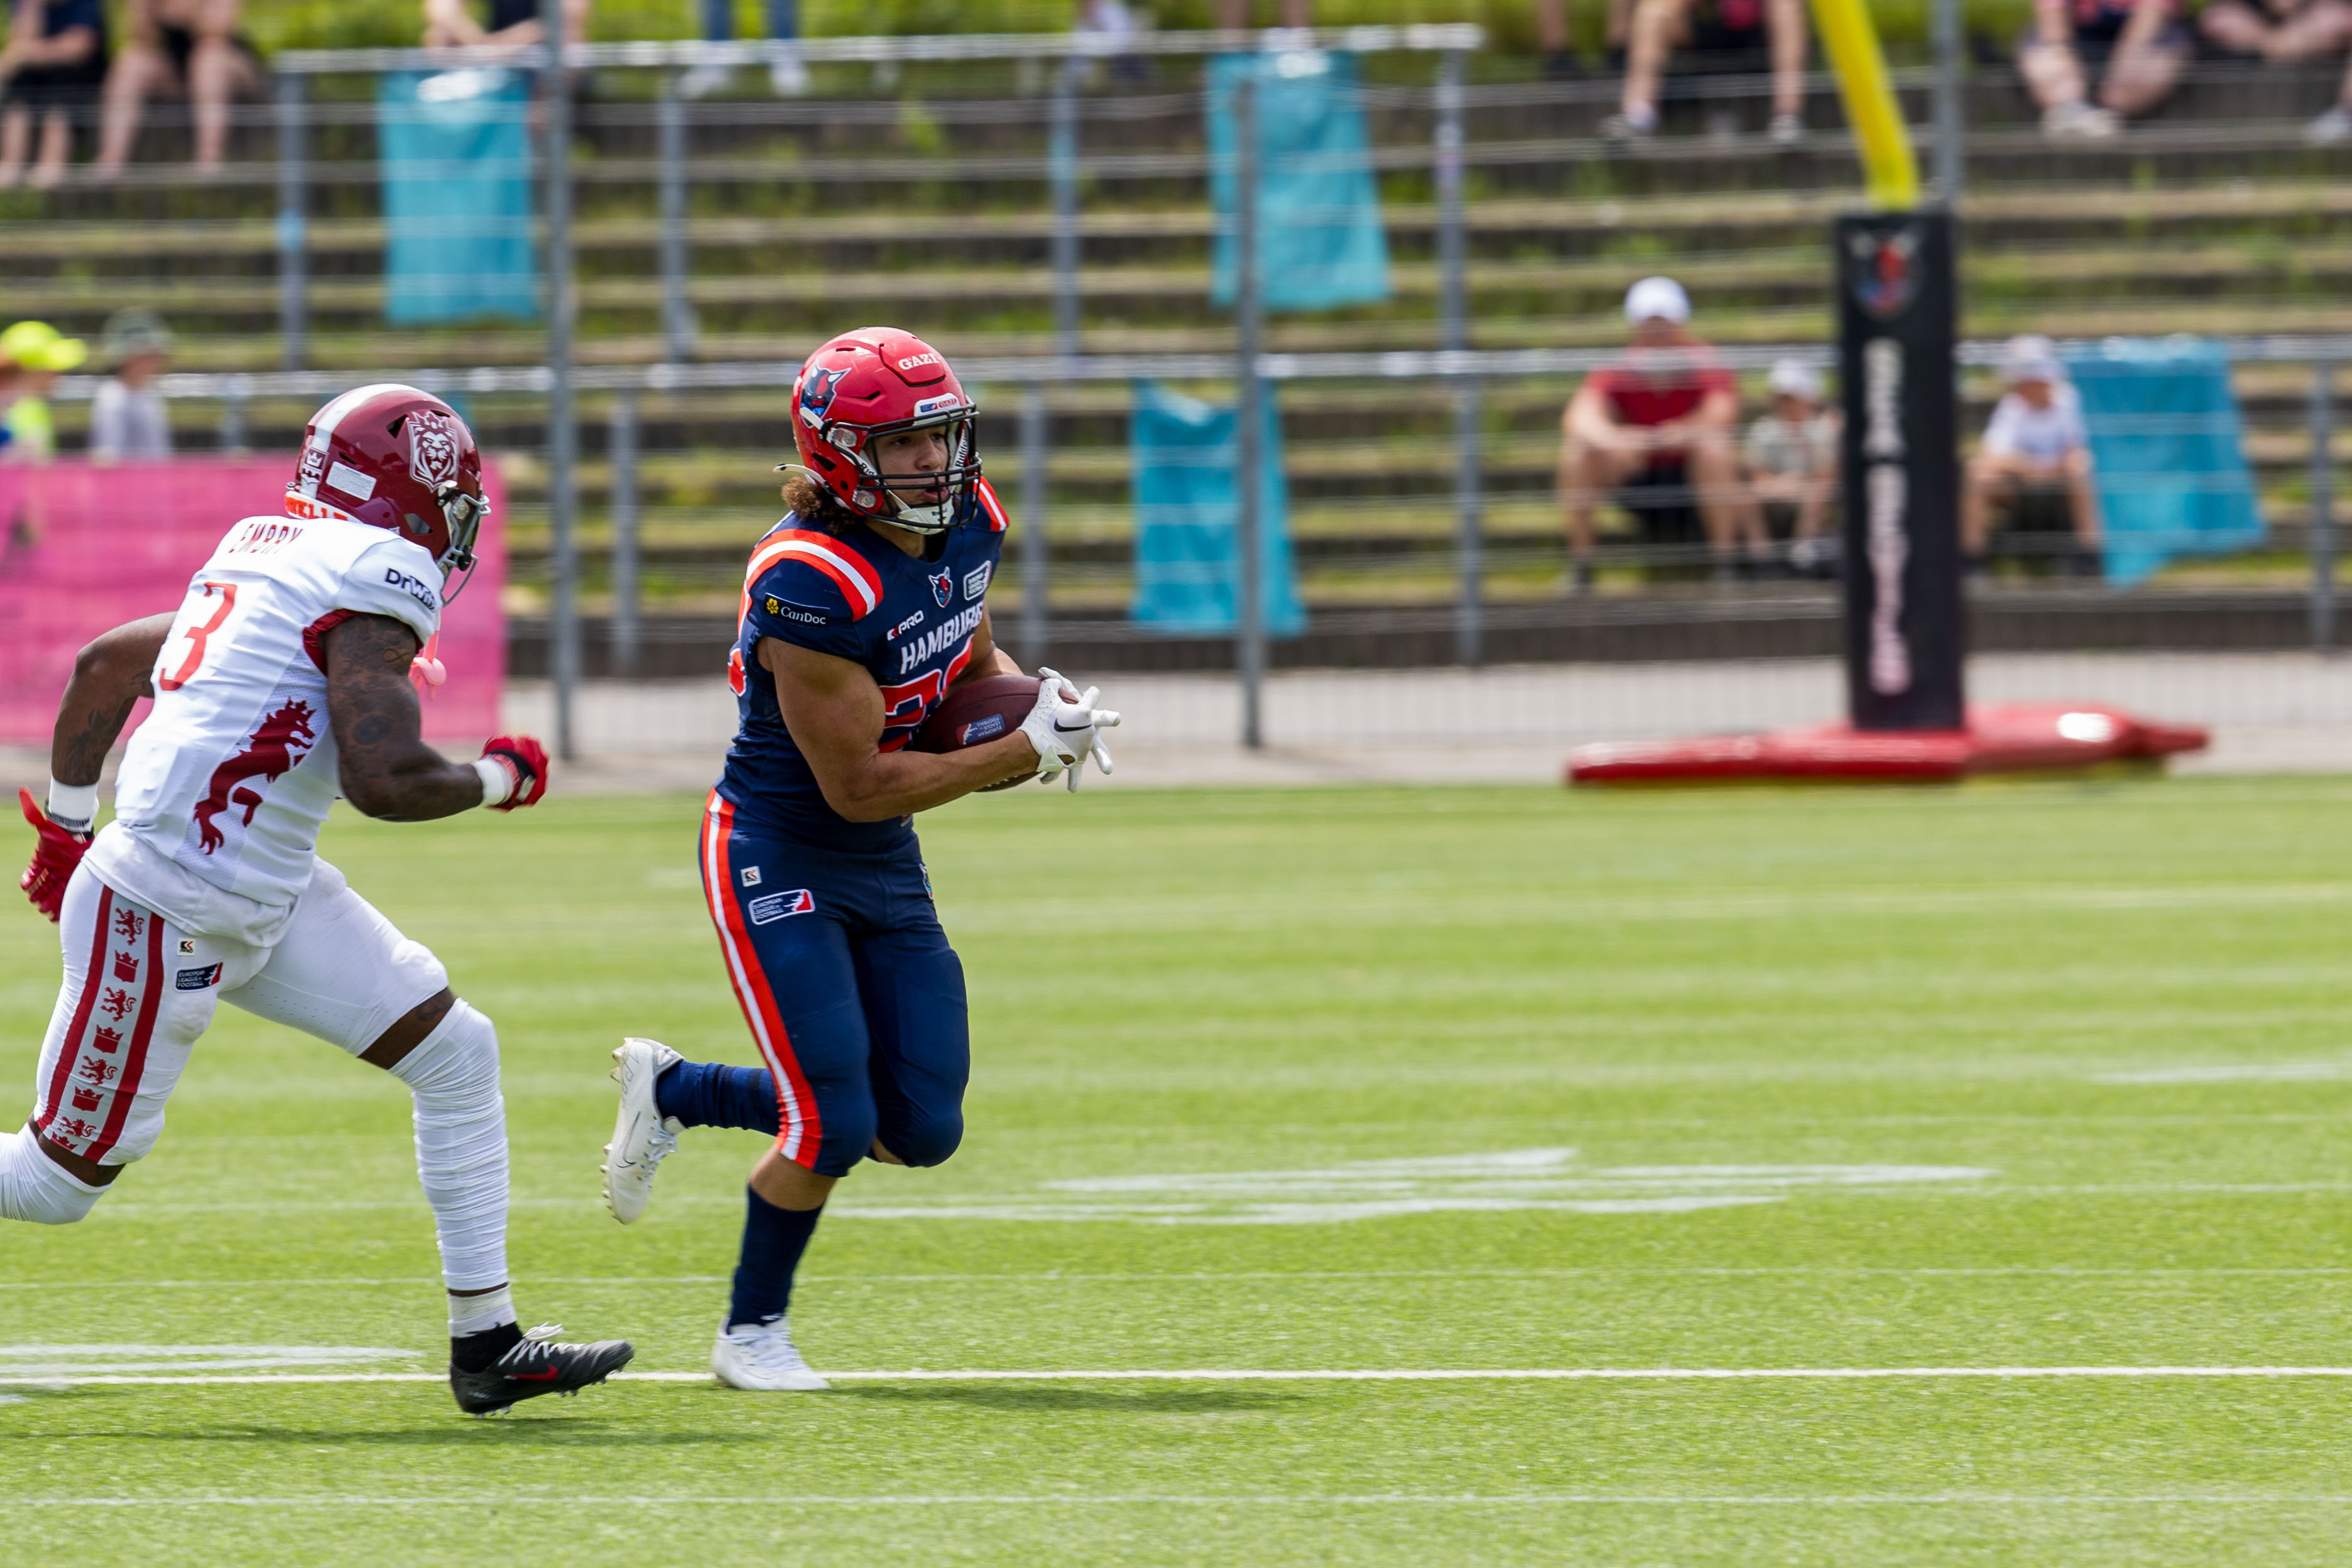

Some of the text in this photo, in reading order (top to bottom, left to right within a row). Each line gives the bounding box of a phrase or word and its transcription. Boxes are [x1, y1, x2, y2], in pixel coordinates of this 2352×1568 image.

[898, 353, 940, 370] GAZI
[781, 606, 826, 624] CanDoc
[160, 582, 237, 692] 3
